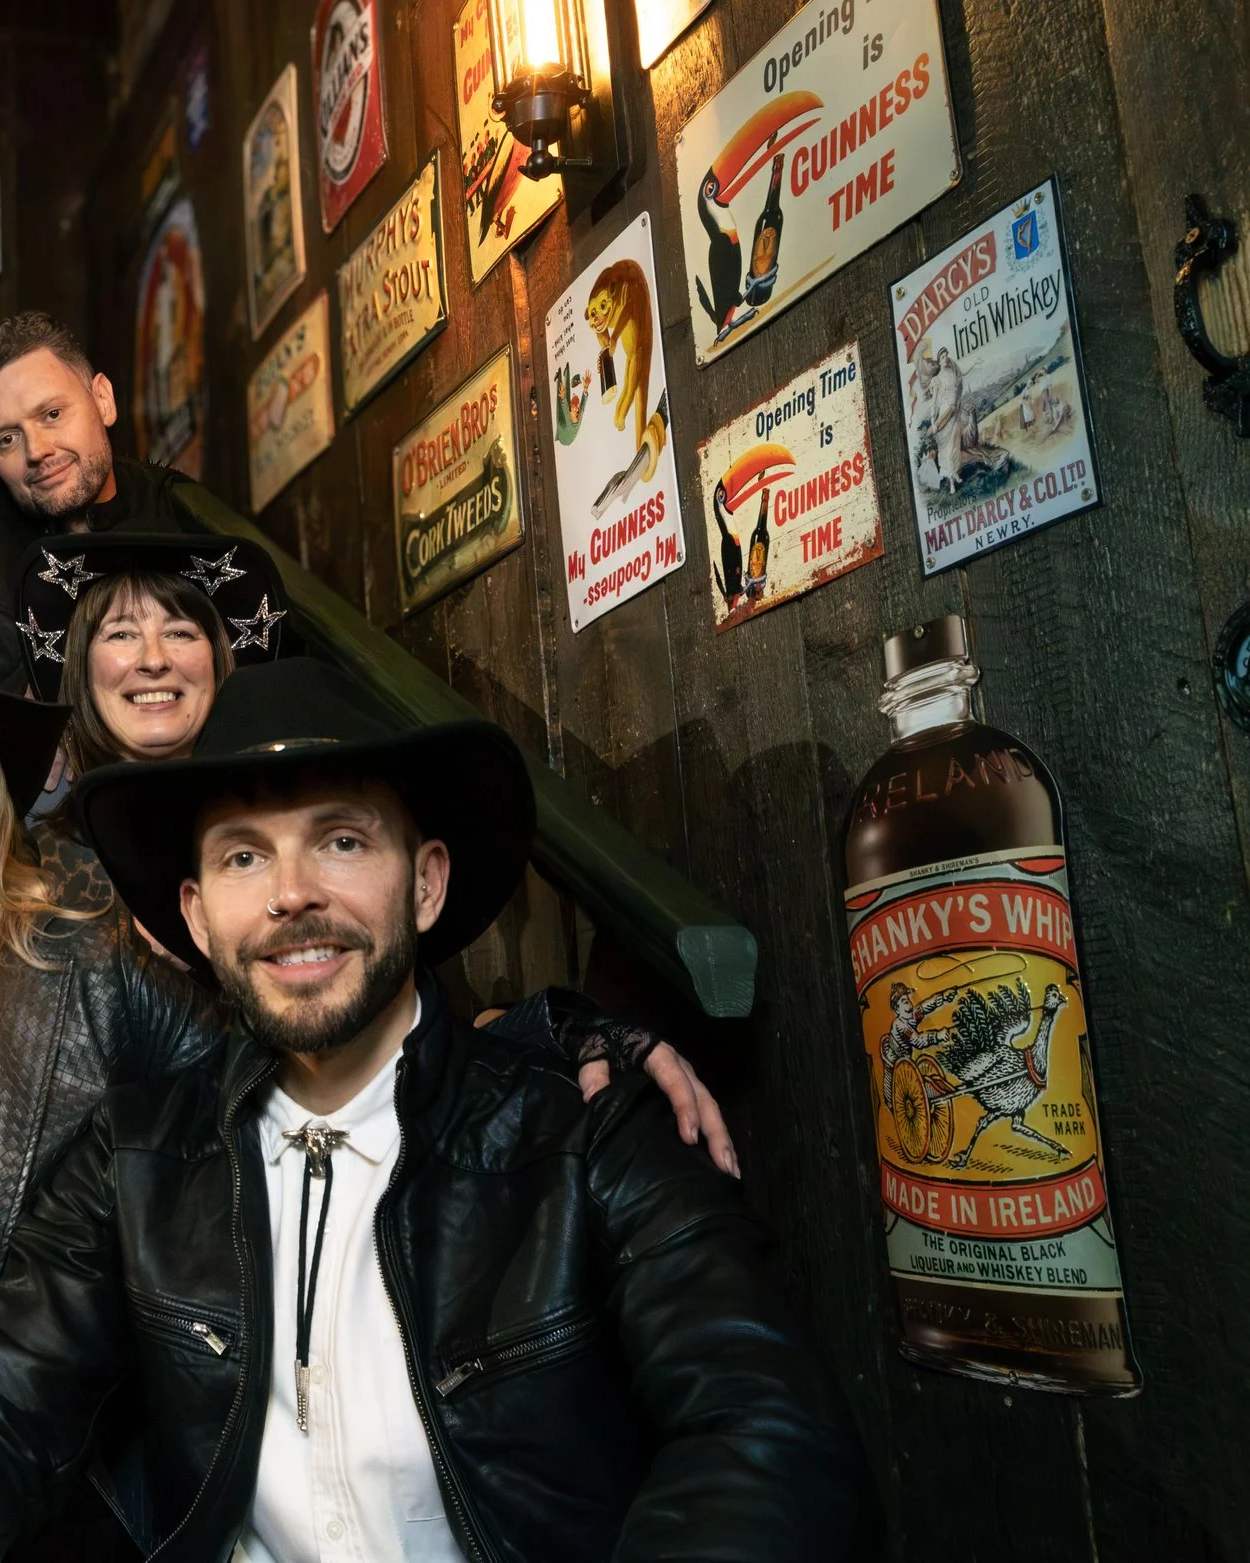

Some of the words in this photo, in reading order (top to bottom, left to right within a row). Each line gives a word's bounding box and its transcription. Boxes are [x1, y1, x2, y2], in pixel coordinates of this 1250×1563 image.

[764, 0, 855, 93] Opening
[862, 33, 884, 71] is
[463, 47, 492, 106] GUIN
[791, 52, 930, 198] GUINNESS
[828, 148, 895, 232] TIME
[383, 260, 432, 313] STOUT
[903, 240, 992, 344] D'ARCY'S
[953, 309, 989, 361] Irish
[987, 269, 1061, 338] Whiskey
[963, 286, 990, 312] OLD
[756, 384, 816, 442] Opening
[819, 361, 857, 399] Time
[402, 418, 462, 498] O'BRIEN
[819, 421, 834, 449] is
[773, 451, 865, 528] GUINNESS
[406, 518, 446, 578] CORK
[446, 476, 503, 547] TWEEDS
[567, 550, 586, 584] My
[590, 490, 665, 566] GUINNESS
[656, 533, 677, 568] My
[800, 515, 843, 564] TIME
[856, 748, 1035, 824] RELAND
[909, 867, 934, 879] SHANKY
[851, 893, 992, 985] SHANKY'S
[1001, 893, 1073, 951] WHIP
[1042, 1103, 1082, 1118] TRADE
[1054, 1121, 1086, 1136] MARK
[886, 1171, 942, 1221] MADE
[951, 1194, 978, 1226] IN
[989, 1176, 1096, 1227] IRELAND
[910, 1254, 955, 1275] LIQUEUR
[956, 1262, 976, 1274] AND
[977, 1263, 1043, 1283] WHISKEY
[1046, 1267, 1088, 1285] BLEND
[921, 1232, 945, 1252] THE
[950, 1240, 1017, 1262] ORIGINAL
[1020, 1240, 1067, 1262] BLACK
